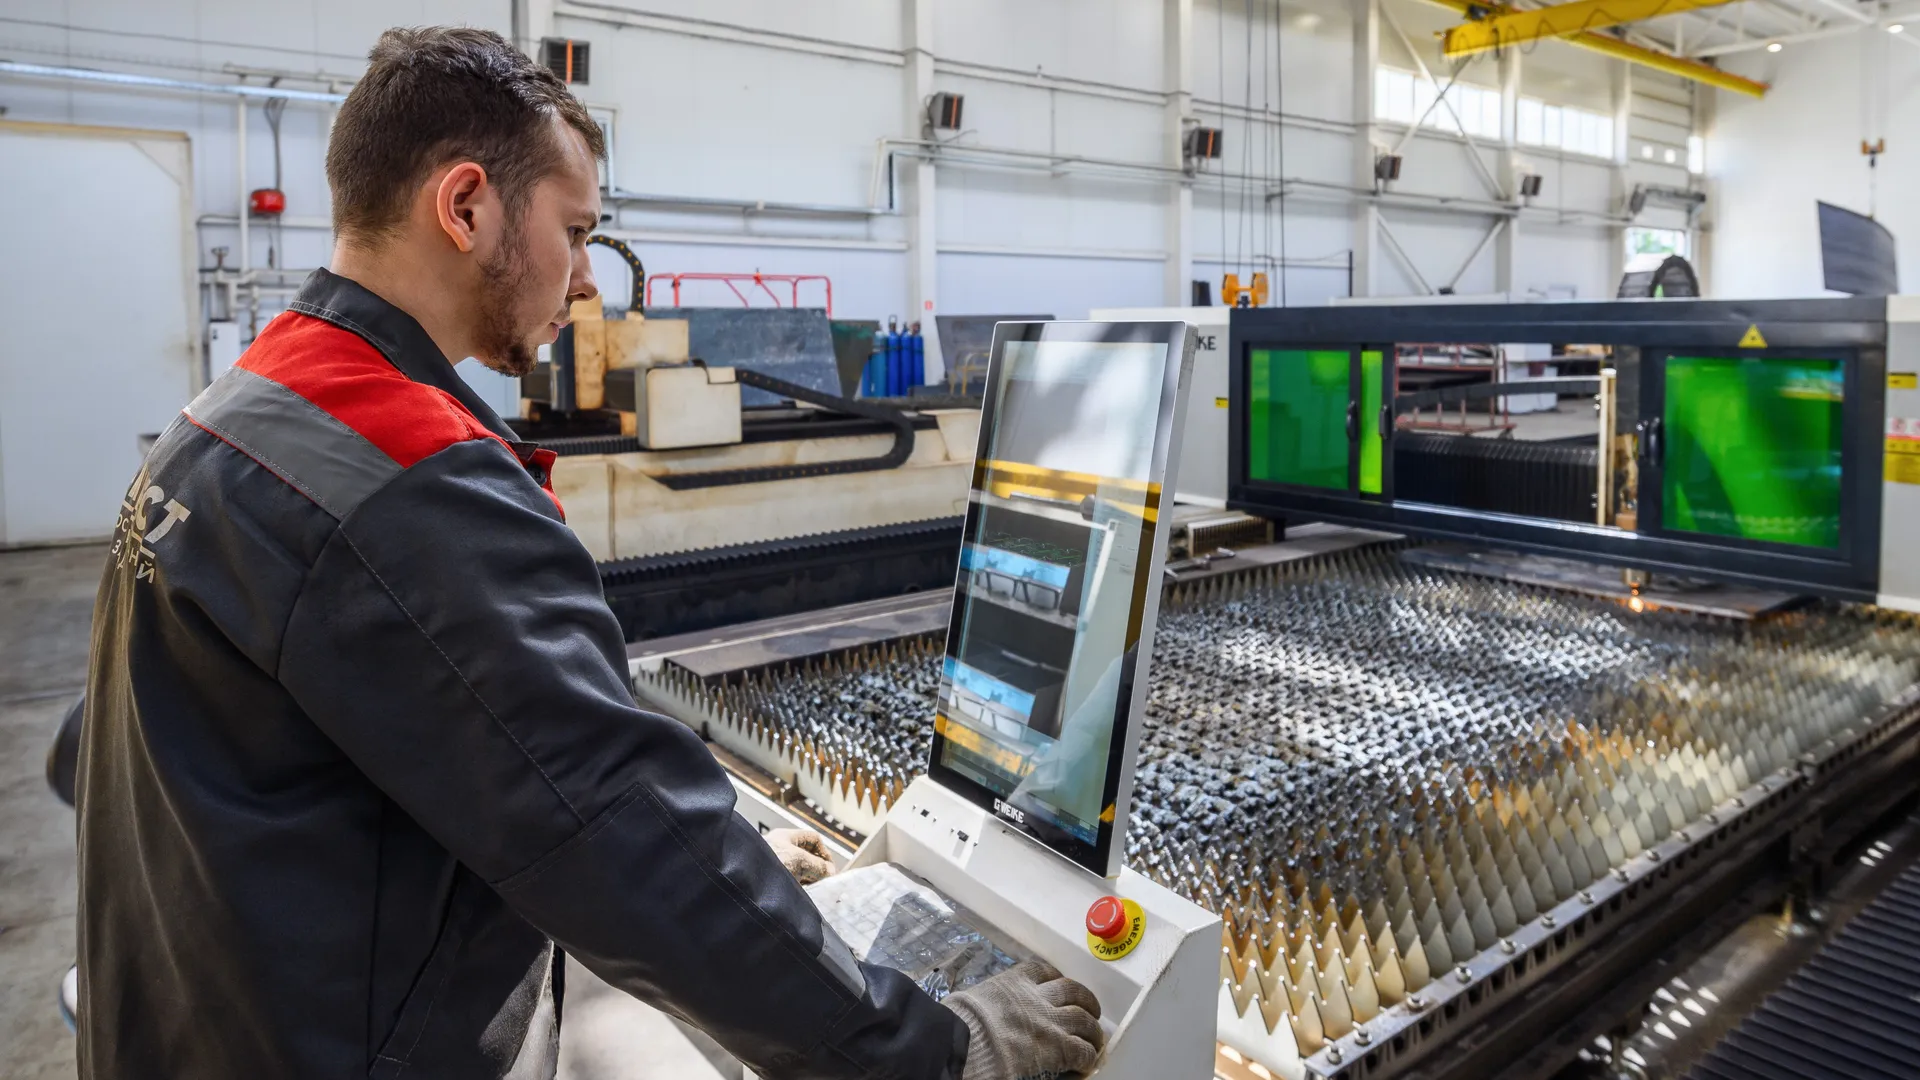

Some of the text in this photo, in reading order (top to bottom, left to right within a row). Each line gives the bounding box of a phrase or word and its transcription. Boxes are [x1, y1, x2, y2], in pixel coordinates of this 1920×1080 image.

[1196, 335, 1217, 351] KE
[993, 797, 1025, 824] GWEIKE
[1093, 916, 1141, 956] EMERGENCY
